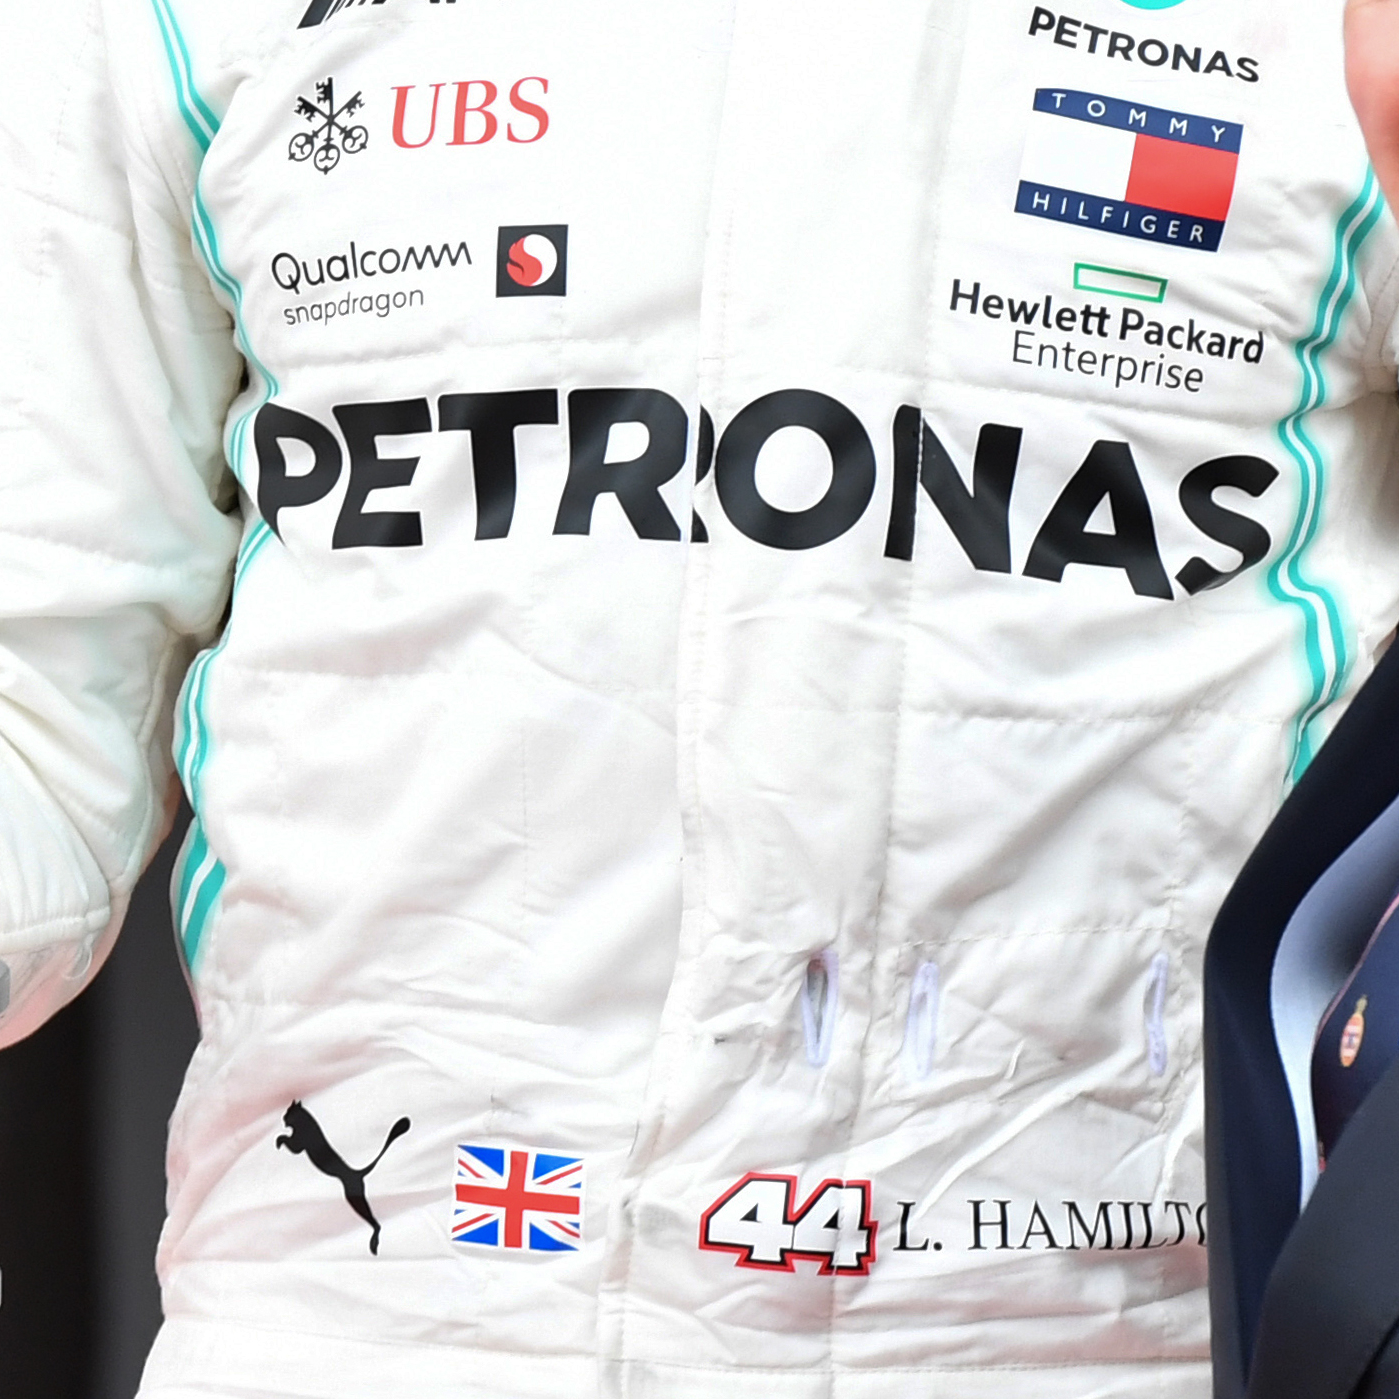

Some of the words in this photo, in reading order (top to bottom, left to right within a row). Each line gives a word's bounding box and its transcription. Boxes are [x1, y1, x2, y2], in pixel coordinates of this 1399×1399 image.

[1028, 6, 1259, 83] PETRONAS
[391, 76, 550, 149] UBS
[1052, 93, 1226, 143] TOMMY
[1032, 191, 1203, 242] HILFIGER
[271, 241, 472, 294] Qualcomm
[283, 289, 424, 326] snapdragon
[949, 278, 1111, 338] Hewlett
[1118, 308, 1264, 364] Packard
[1012, 329, 1203, 393] Enterprise
[256, 387, 1280, 601] PETRONAS
[698, 1171, 879, 1277] 44
[892, 1200, 943, 1252] L.
[967, 1199, 1207, 1252] HAMILT
